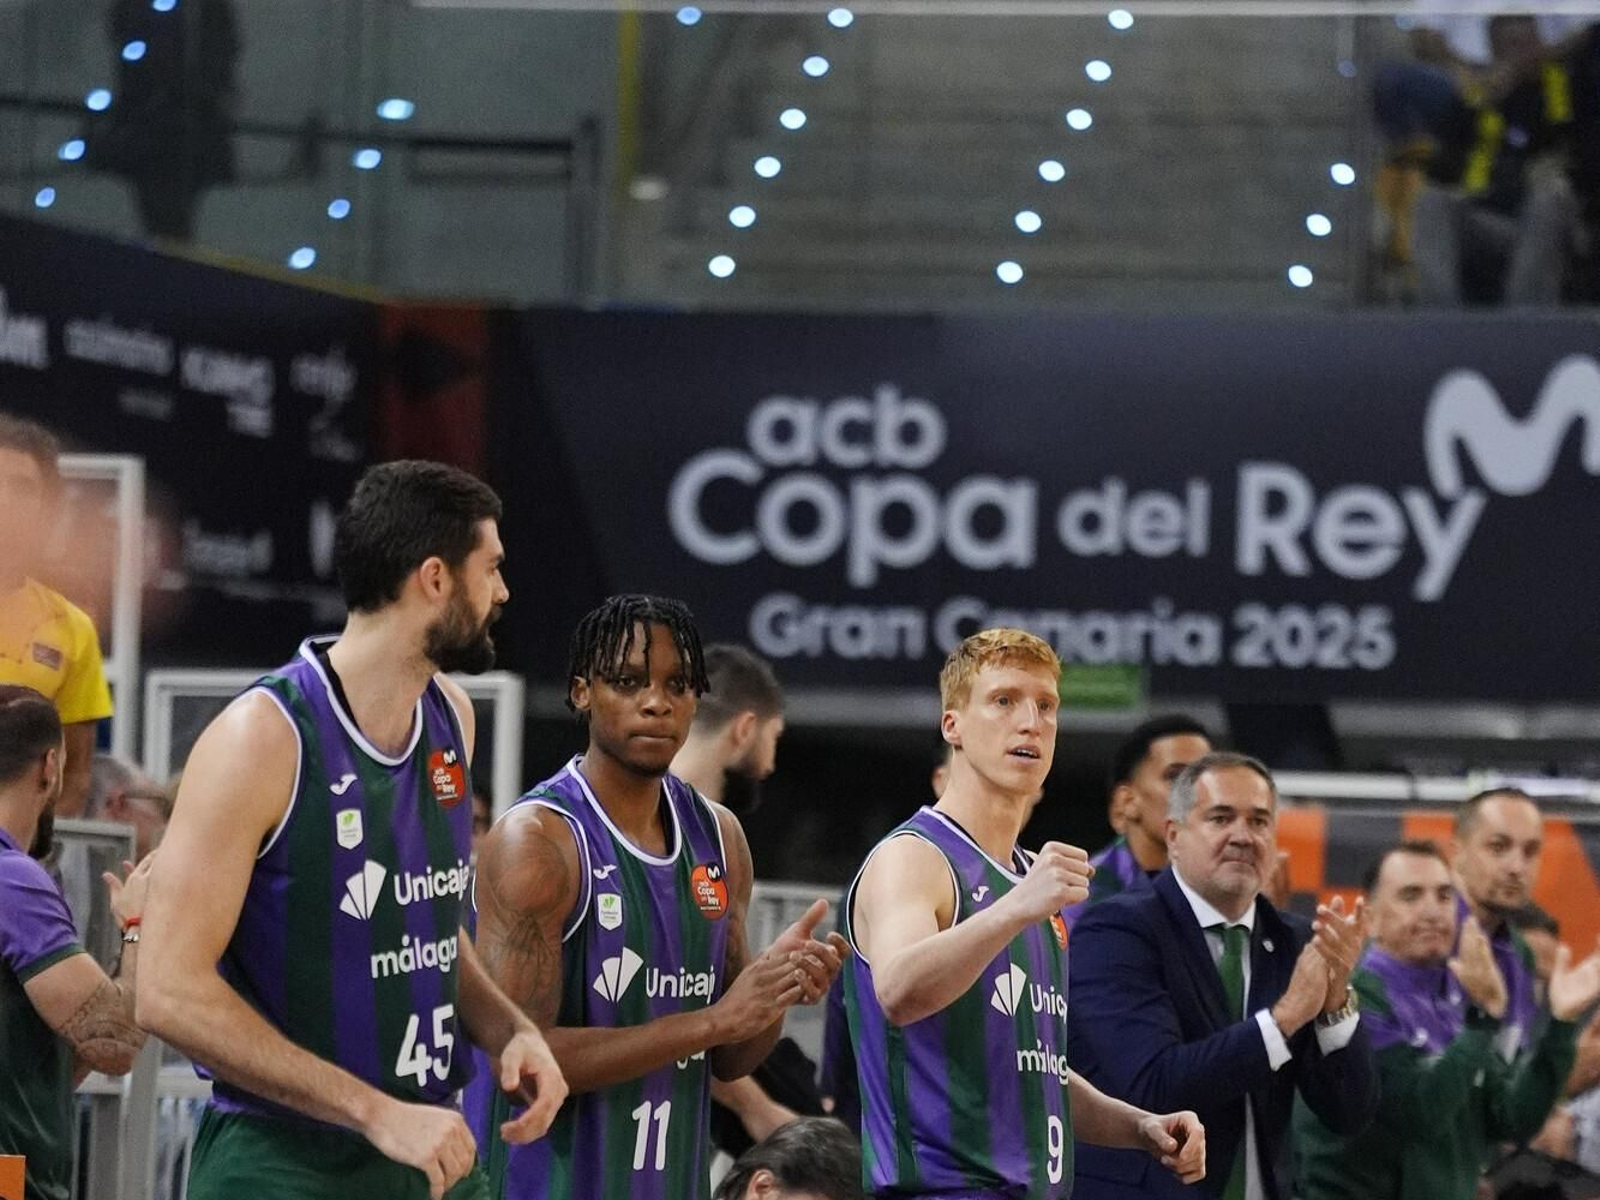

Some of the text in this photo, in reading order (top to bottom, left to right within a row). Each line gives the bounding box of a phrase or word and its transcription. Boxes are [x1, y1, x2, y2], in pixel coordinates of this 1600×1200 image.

[747, 384, 946, 468] acb
[667, 449, 1487, 600] Copa del Rey
[749, 594, 1397, 669] Gran Cnaria 2025
[646, 964, 716, 1005] Unicaj
[395, 1004, 455, 1087] 45
[632, 1100, 672, 1170] 11
[1047, 1115, 1063, 1185] 9
